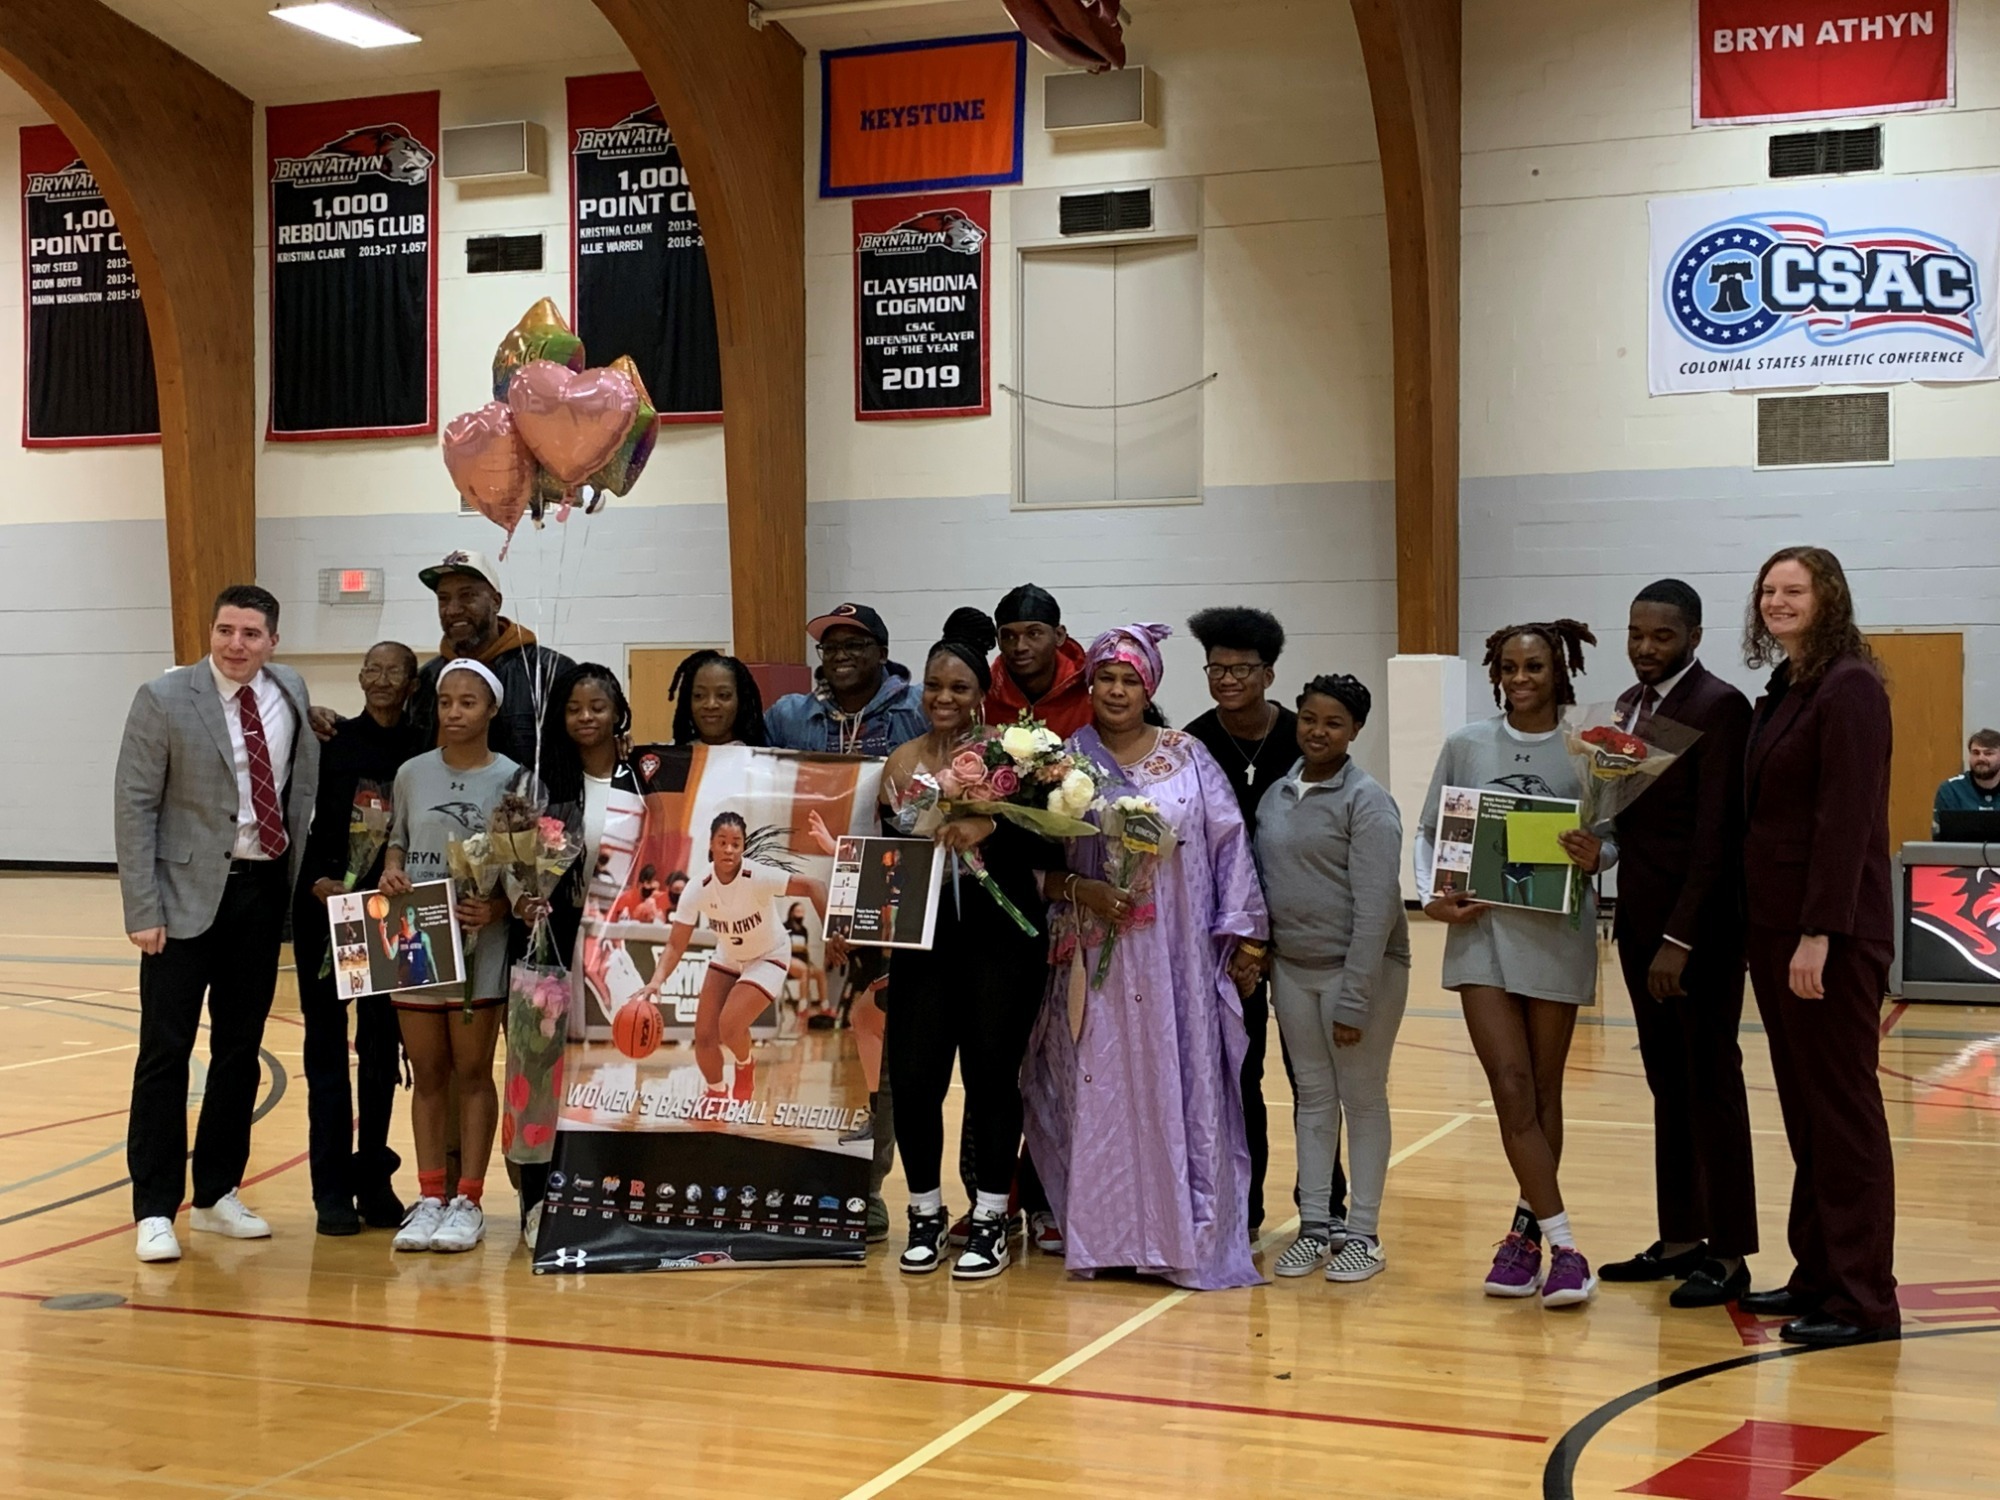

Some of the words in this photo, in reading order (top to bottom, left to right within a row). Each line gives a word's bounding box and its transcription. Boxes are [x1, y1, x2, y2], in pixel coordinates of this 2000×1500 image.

[1713, 23, 1804, 53] BRYN
[1816, 10, 1933, 45] ATHYN
[860, 98, 985, 131] KEYSTONE
[312, 192, 388, 220] 1,000
[580, 193, 665, 220] POINT
[670, 191, 697, 213] CL
[63, 209, 116, 233] 1,00
[278, 218, 375, 245] REBOUNDS
[378, 214, 425, 237] CLUB
[580, 226, 621, 239] KRISTINA
[623, 222, 653, 235] CLARK
[668, 219, 698, 232] 2013-
[31, 233, 104, 257] POINT
[277, 250, 316, 263] KRISTINA
[317, 248, 346, 260] CLARK
[358, 244, 397, 257] 2013-17
[401, 241, 427, 255] 1,057
[580, 242, 604, 255] ALLIE
[606, 239, 643, 252] WARREN
[667, 235, 705, 249] 2016-2
[32, 263, 51, 274] TROY
[52, 261, 79, 273] STEED
[106, 258, 132, 269] 2013-
[106, 273, 136, 285] 2013-1
[863, 273, 979, 296] CLAYSHONIA
[1764, 243, 1973, 313] CSAC
[876, 295, 966, 316] COGMON
[865, 333, 927, 346] DEFENSIVE
[930, 330, 975, 342] PLAYER
[905, 321, 936, 333] CSAC
[883, 345, 899, 356] OF
[901, 344, 923, 354] THE
[926, 342, 959, 353] YEAR
[1679, 358, 1751, 375] COLONIAL
[1757, 356, 1806, 370] STATES
[1810, 352, 1873, 367] ATHLETIC
[1878, 351, 1965, 364] CONFERENCE
[882, 364, 960, 390] 2019
[566, 1083, 653, 1115] WOMEN'S
[655, 1094, 767, 1126] BASKETBALL
[772, 1102, 866, 1131] SCHEDULE
[629, 1180, 645, 1197] R
[793, 1194, 813, 1206] KC
